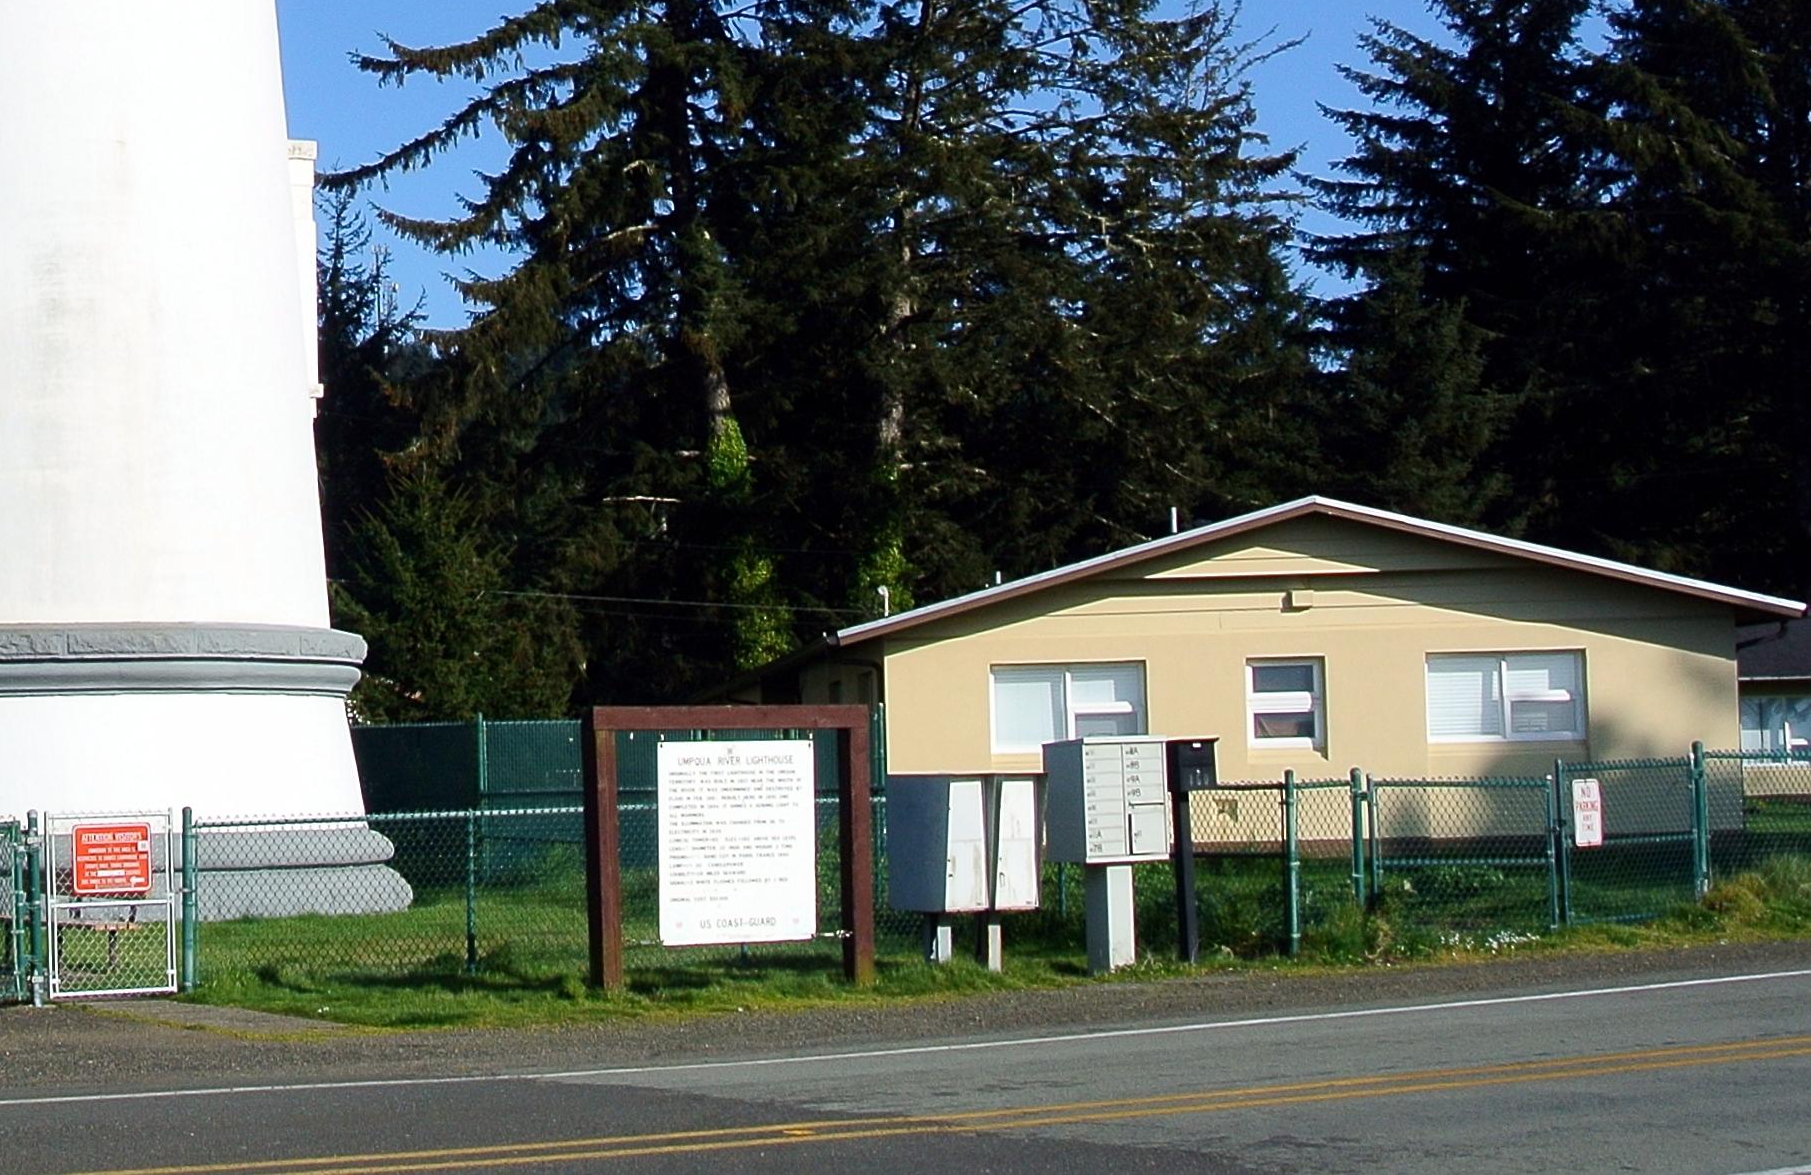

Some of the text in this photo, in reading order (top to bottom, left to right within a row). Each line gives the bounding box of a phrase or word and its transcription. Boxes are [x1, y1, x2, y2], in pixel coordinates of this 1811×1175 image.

[678, 754, 794, 766] UMPQUA RIVER LIGHTHOUSE
[1580, 786, 1592, 797] NO
